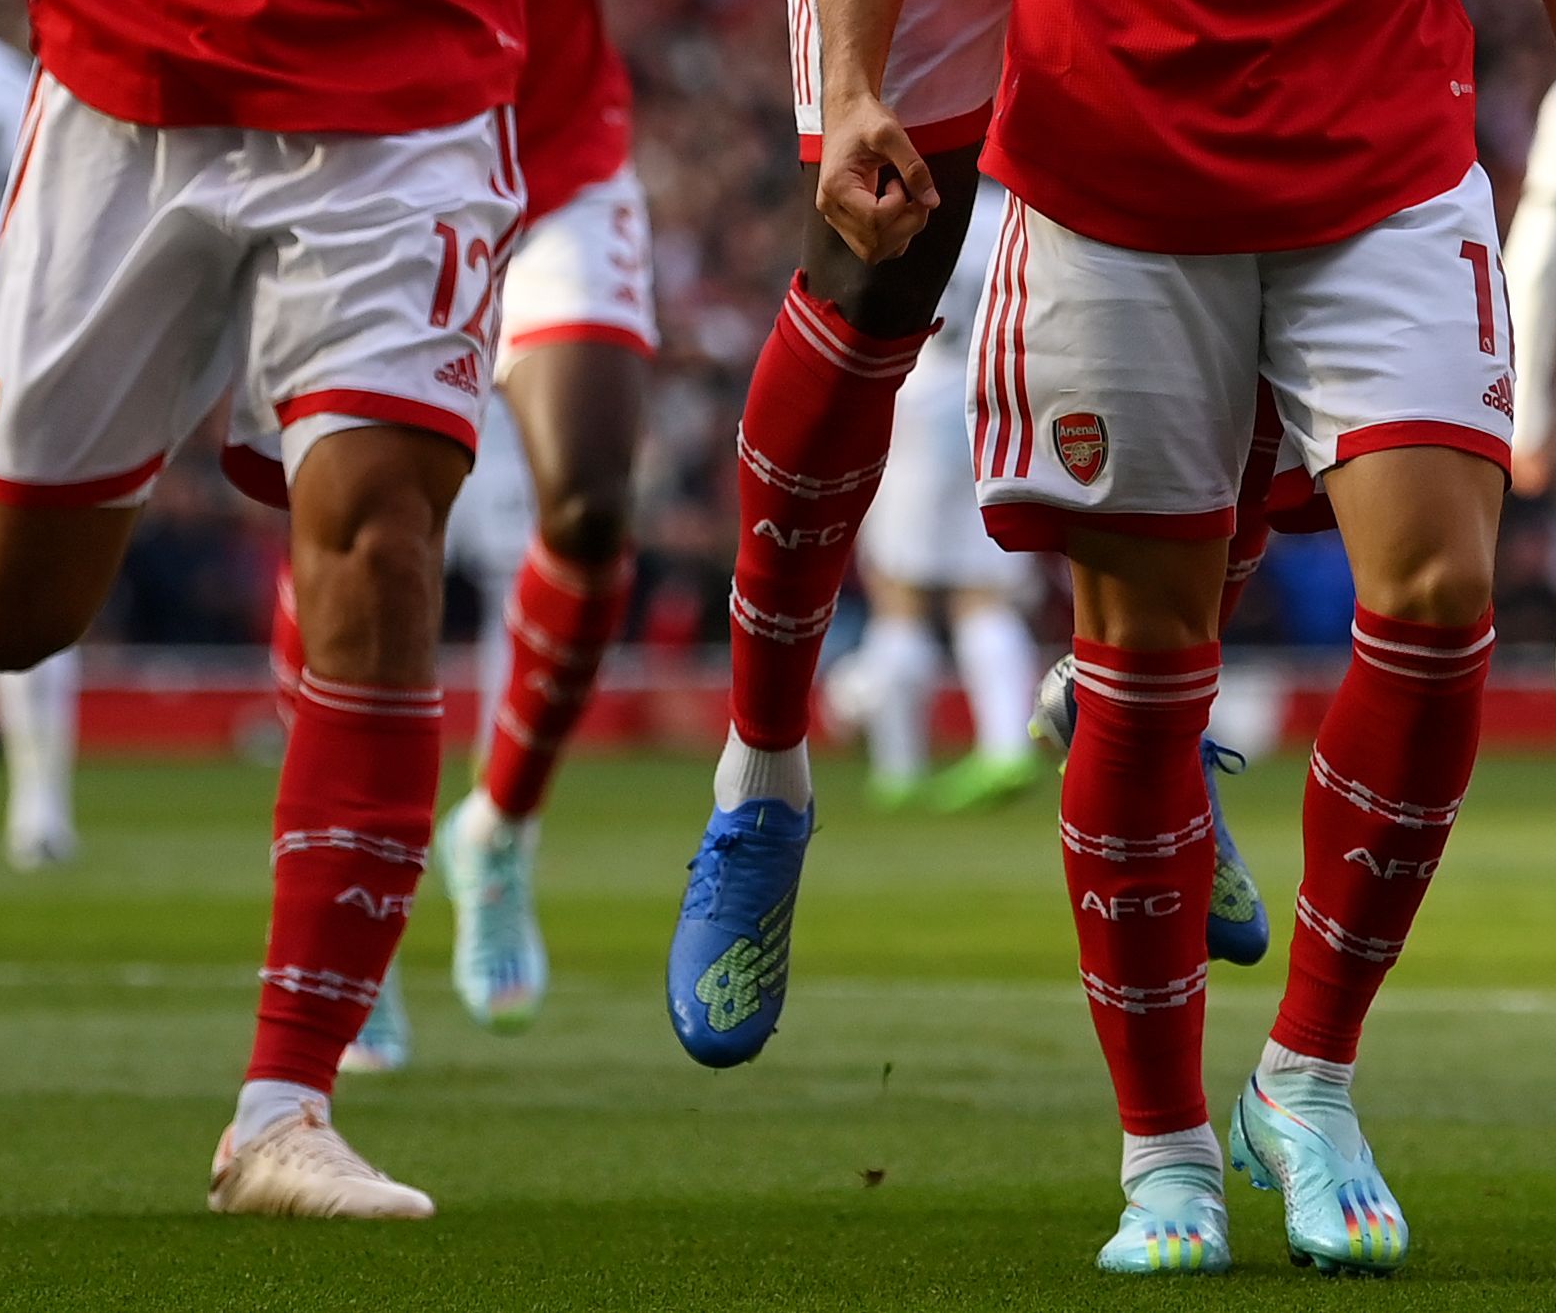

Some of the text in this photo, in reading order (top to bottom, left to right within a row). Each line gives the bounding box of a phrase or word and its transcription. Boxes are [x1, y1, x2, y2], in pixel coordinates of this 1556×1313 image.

[430, 220, 493, 346] 12
[752, 518, 847, 550] AFC
[1343, 847, 1441, 880] AFC
[1081, 890, 1182, 922] AFC
